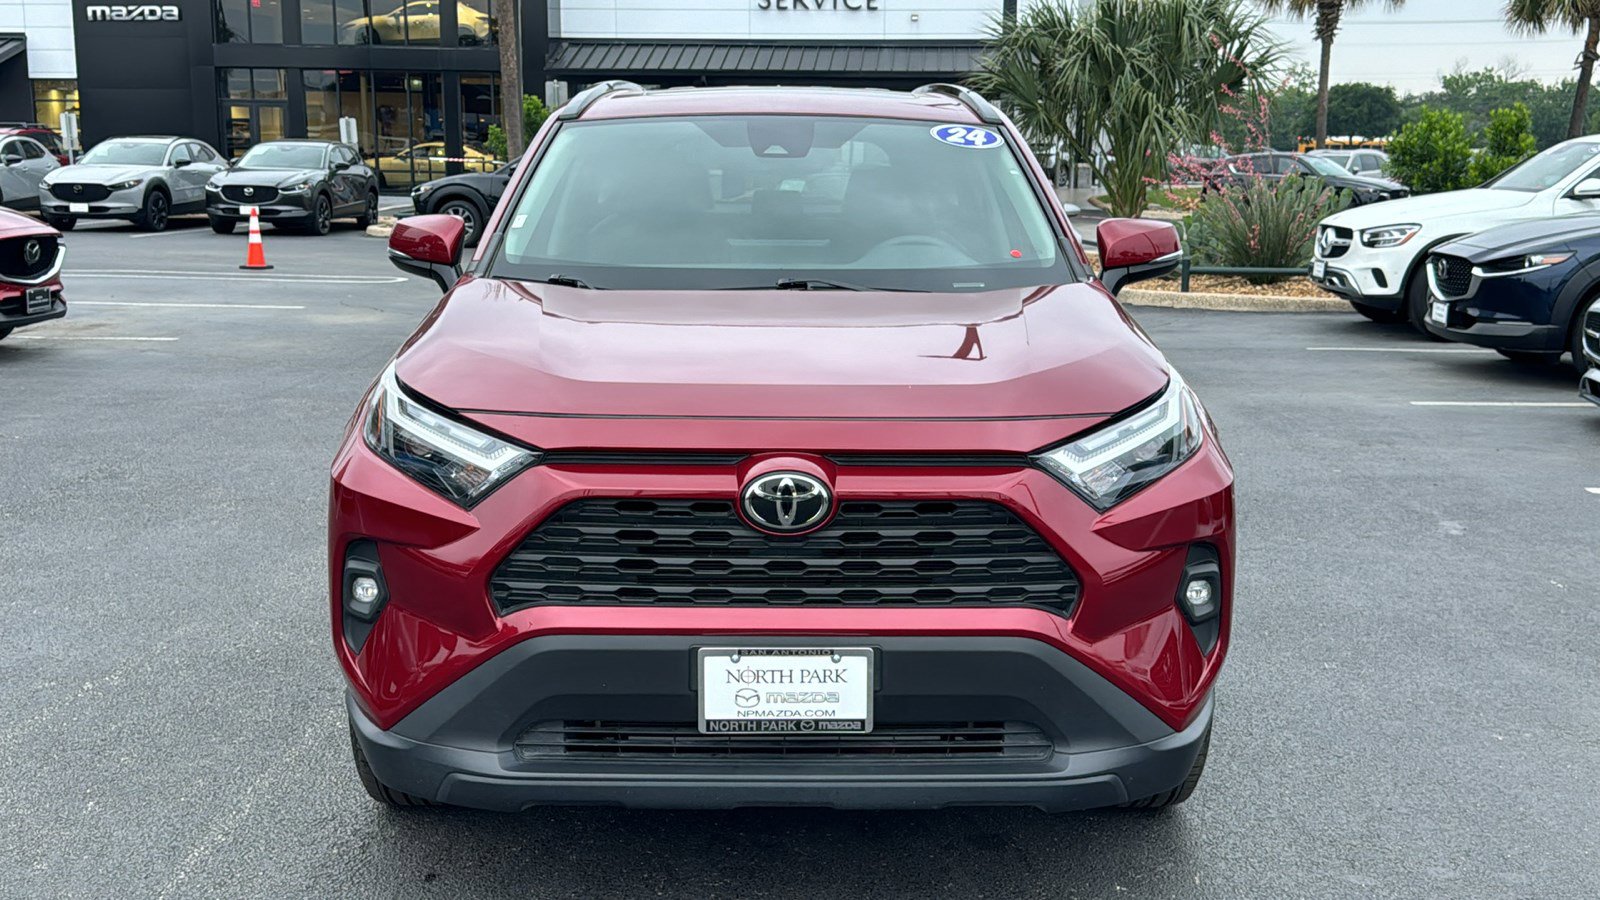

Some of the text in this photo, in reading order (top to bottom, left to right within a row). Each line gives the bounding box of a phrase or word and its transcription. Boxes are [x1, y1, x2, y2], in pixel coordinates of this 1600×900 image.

[86, 5, 179, 20] mazda
[946, 127, 987, 146] 24
[726, 669, 847, 683] NORTH PARK
[766, 692, 839, 703] mazda
[710, 721, 861, 731] NORTH PARK mazda
